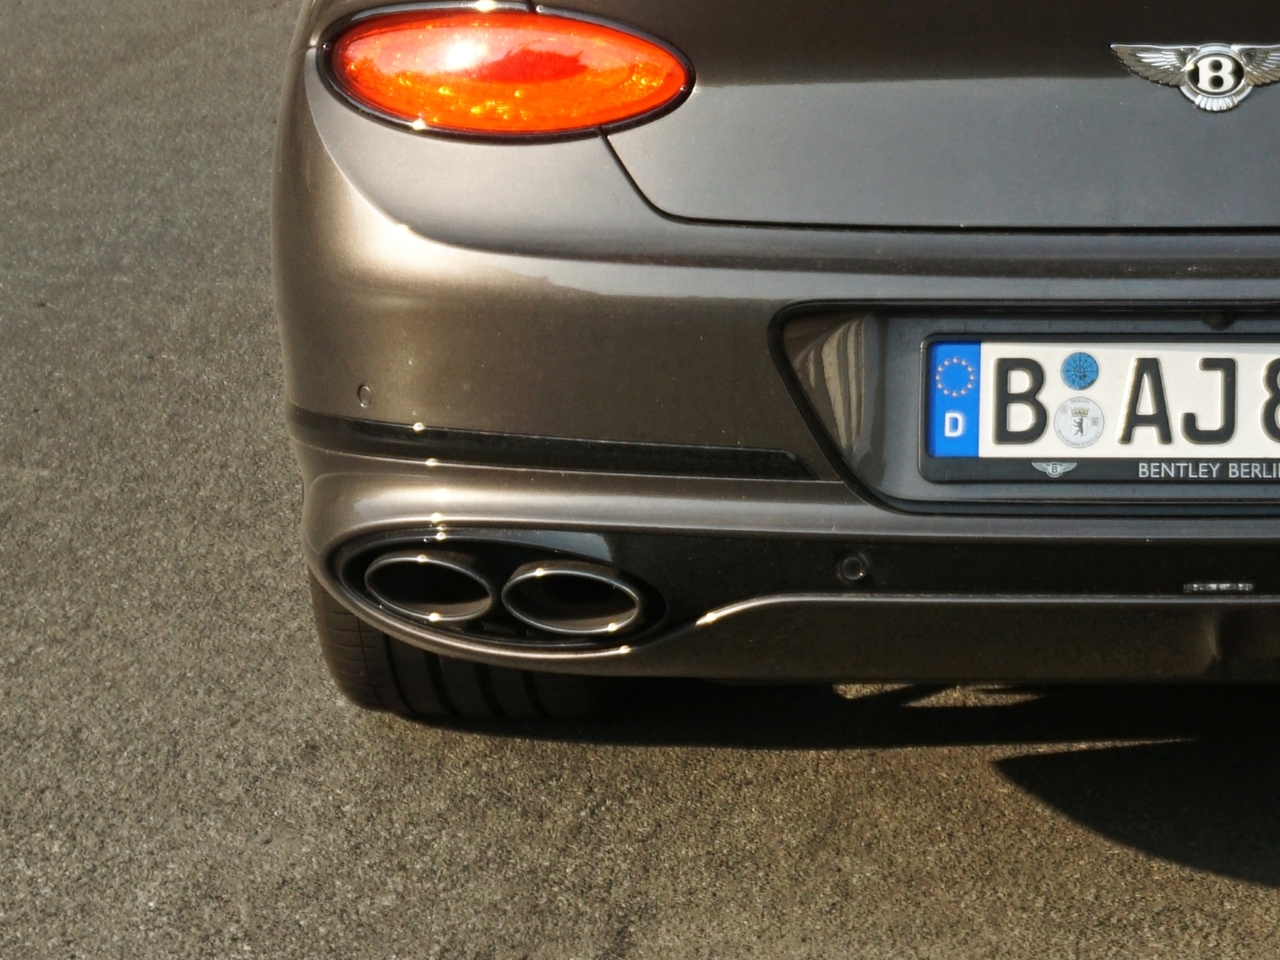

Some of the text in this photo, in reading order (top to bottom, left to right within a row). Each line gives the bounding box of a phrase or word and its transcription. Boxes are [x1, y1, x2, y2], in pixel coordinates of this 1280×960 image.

[994, 358, 1048, 445] B
[1119, 358, 1238, 445] AJ
[944, 410, 966, 437] D
[1138, 462, 1221, 478] BENTLEY
